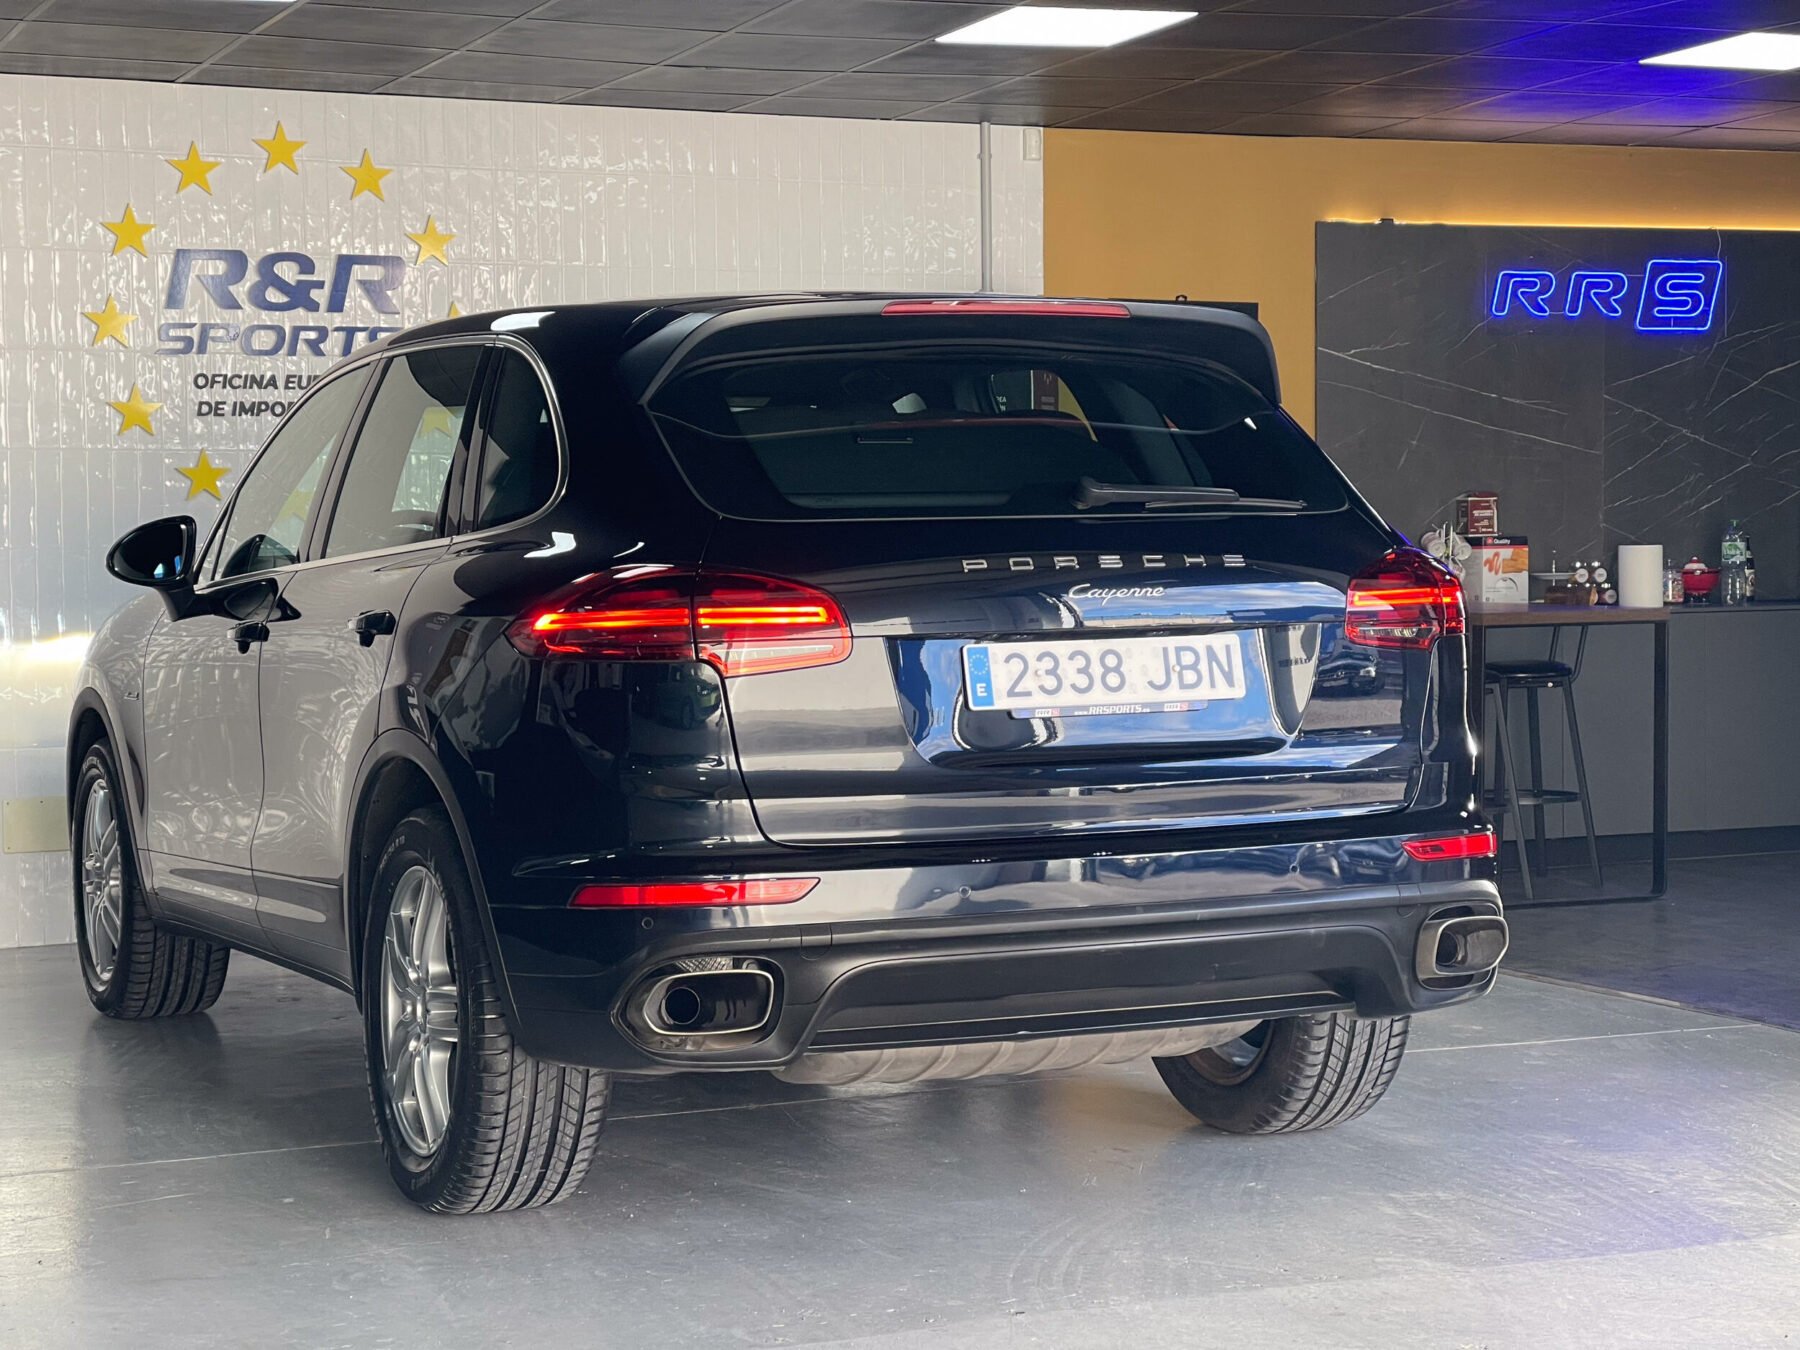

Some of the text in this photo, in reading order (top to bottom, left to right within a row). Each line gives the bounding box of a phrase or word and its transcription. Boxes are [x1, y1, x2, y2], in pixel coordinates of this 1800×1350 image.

[163, 248, 406, 314] R&R
[193, 372, 279, 390] OFICINA
[196, 400, 296, 418] DE IMPO
[961, 554, 1247, 573] PORSCHE
[1065, 583, 1167, 606] Cayenne
[1003, 643, 1236, 698] 2338 JBN
[975, 682, 988, 697] E
